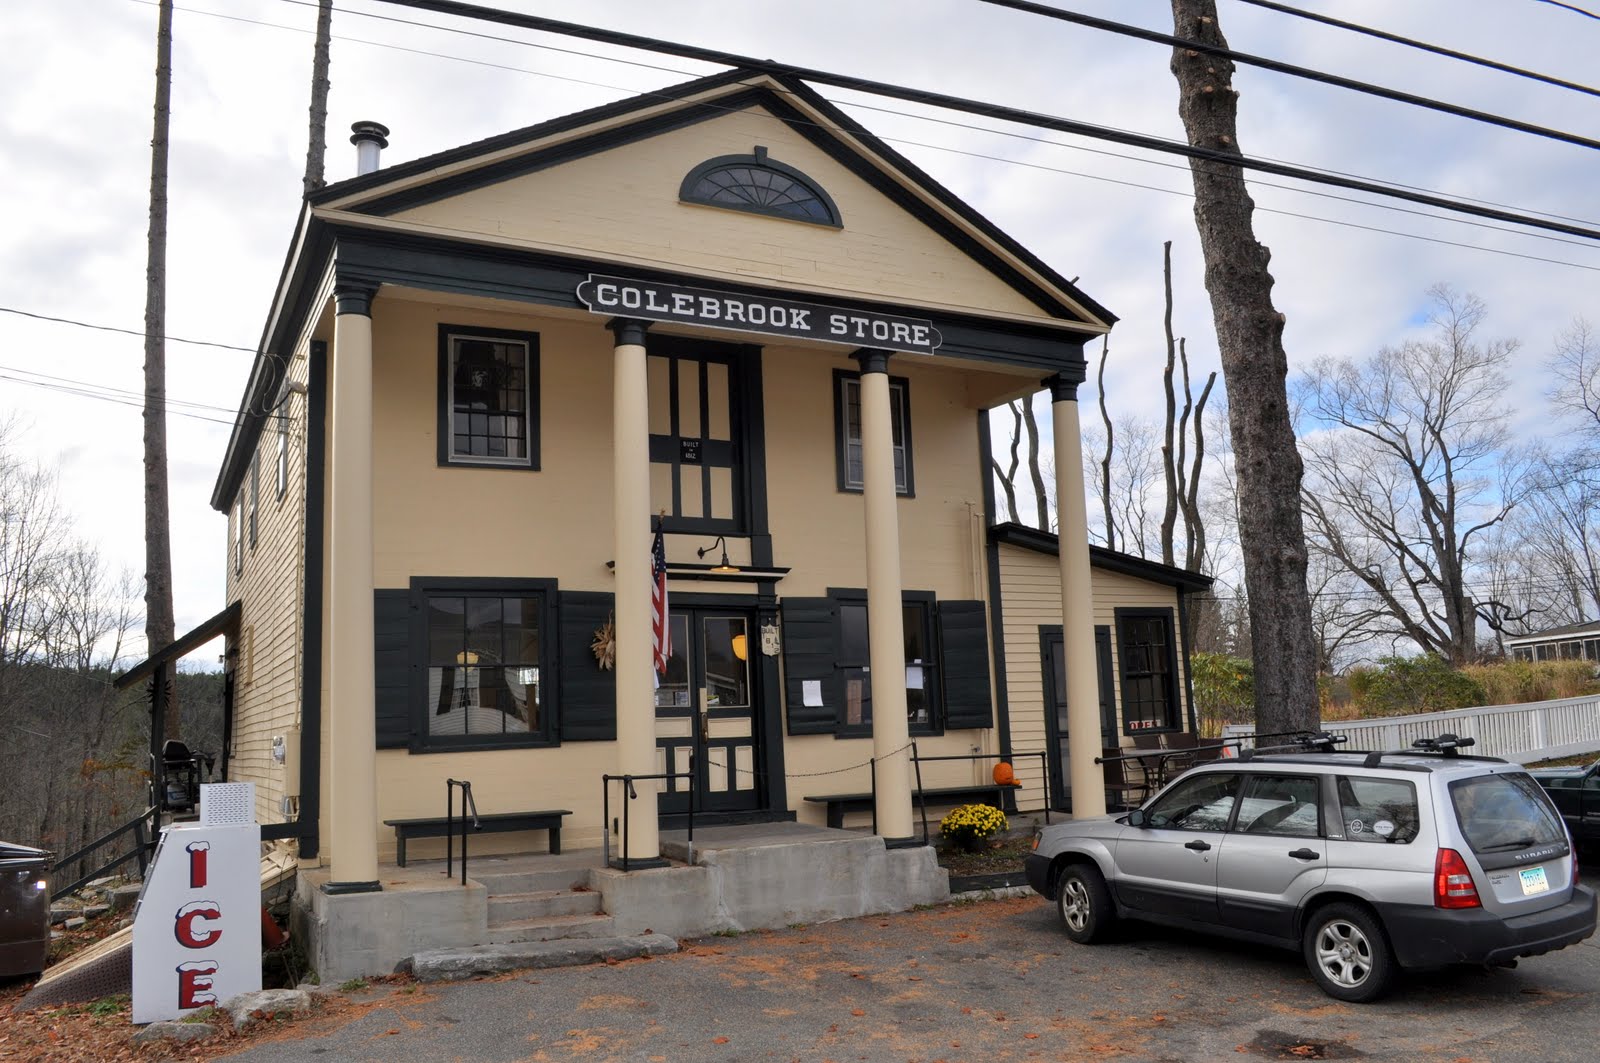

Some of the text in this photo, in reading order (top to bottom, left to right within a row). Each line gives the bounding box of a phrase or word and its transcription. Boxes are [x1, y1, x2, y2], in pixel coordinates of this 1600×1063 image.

[597, 283, 931, 346] COLEBROOK STORE
[1129, 721, 1157, 731] OPEN
[1514, 849, 1554, 861] SUBARU
[173, 840, 224, 1011] ICE
